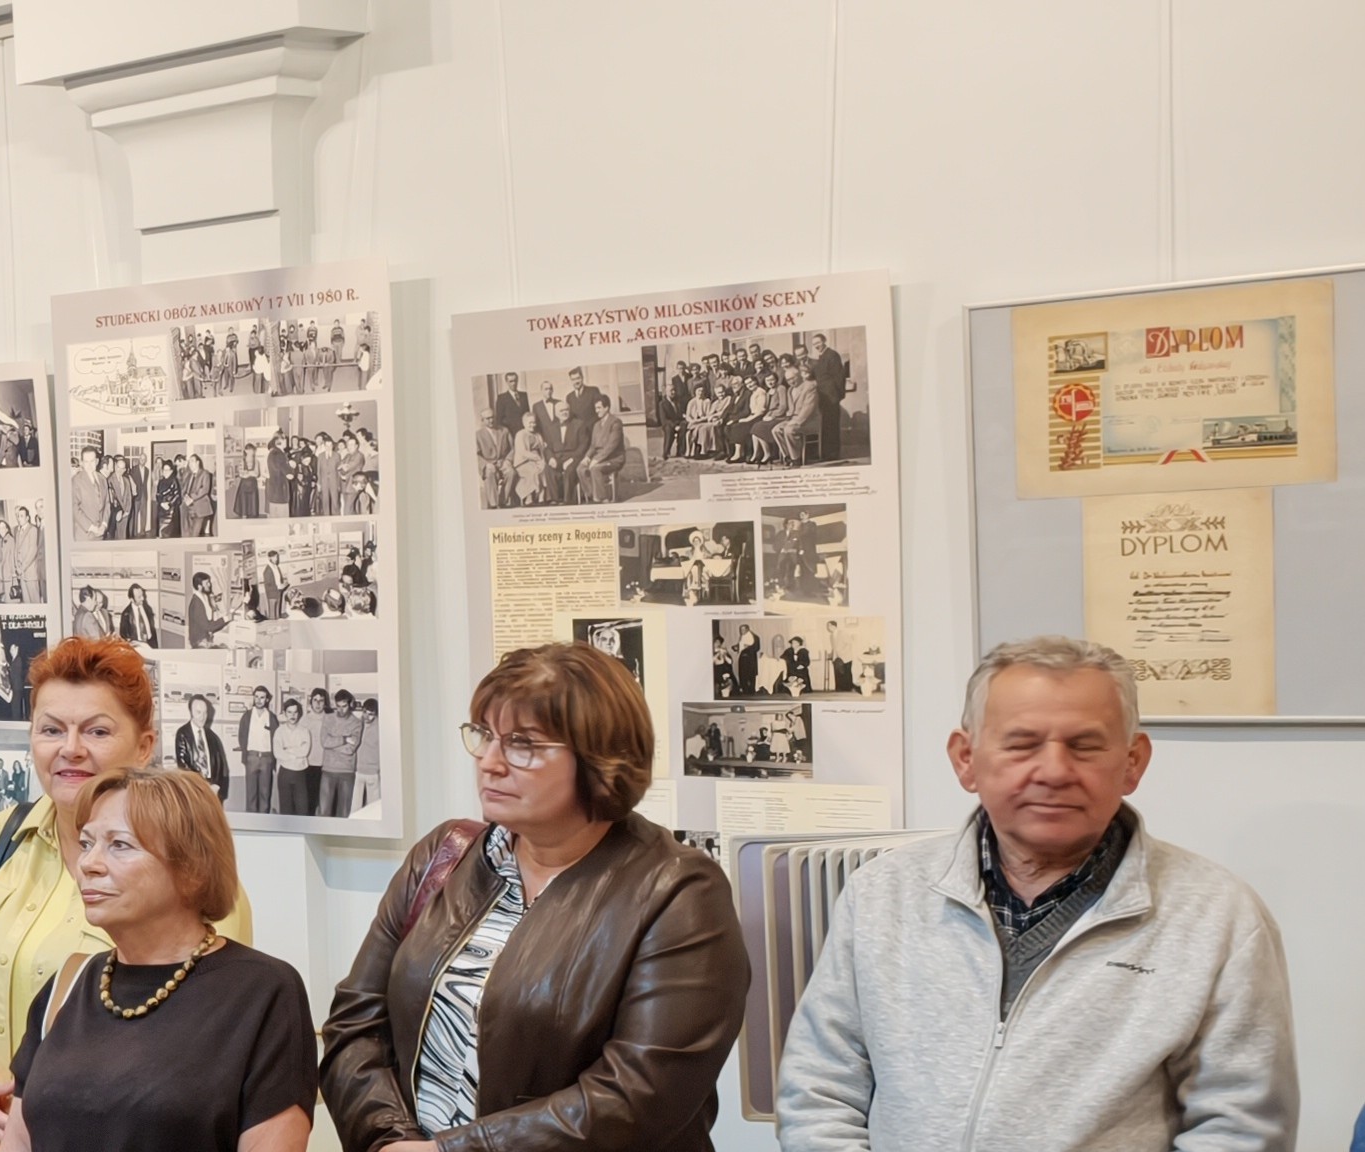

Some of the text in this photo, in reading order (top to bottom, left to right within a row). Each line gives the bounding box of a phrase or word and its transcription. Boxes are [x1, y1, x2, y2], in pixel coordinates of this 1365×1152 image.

[96, 288, 359, 328] STUDENCKI OBÓZ NAUKOWY 17 VII 1980 R.
[526, 305, 649, 332] TOWARZYSTWO
[762, 286, 820, 308] SCENY
[543, 330, 585, 350] PRZY
[589, 330, 621, 346] FMR
[1146, 325, 1243, 358] DYPLOM
[492, 531, 534, 545] Miłośnicy
[538, 532, 563, 543] sceny
[1120, 533, 1228, 557] DYPLOM
